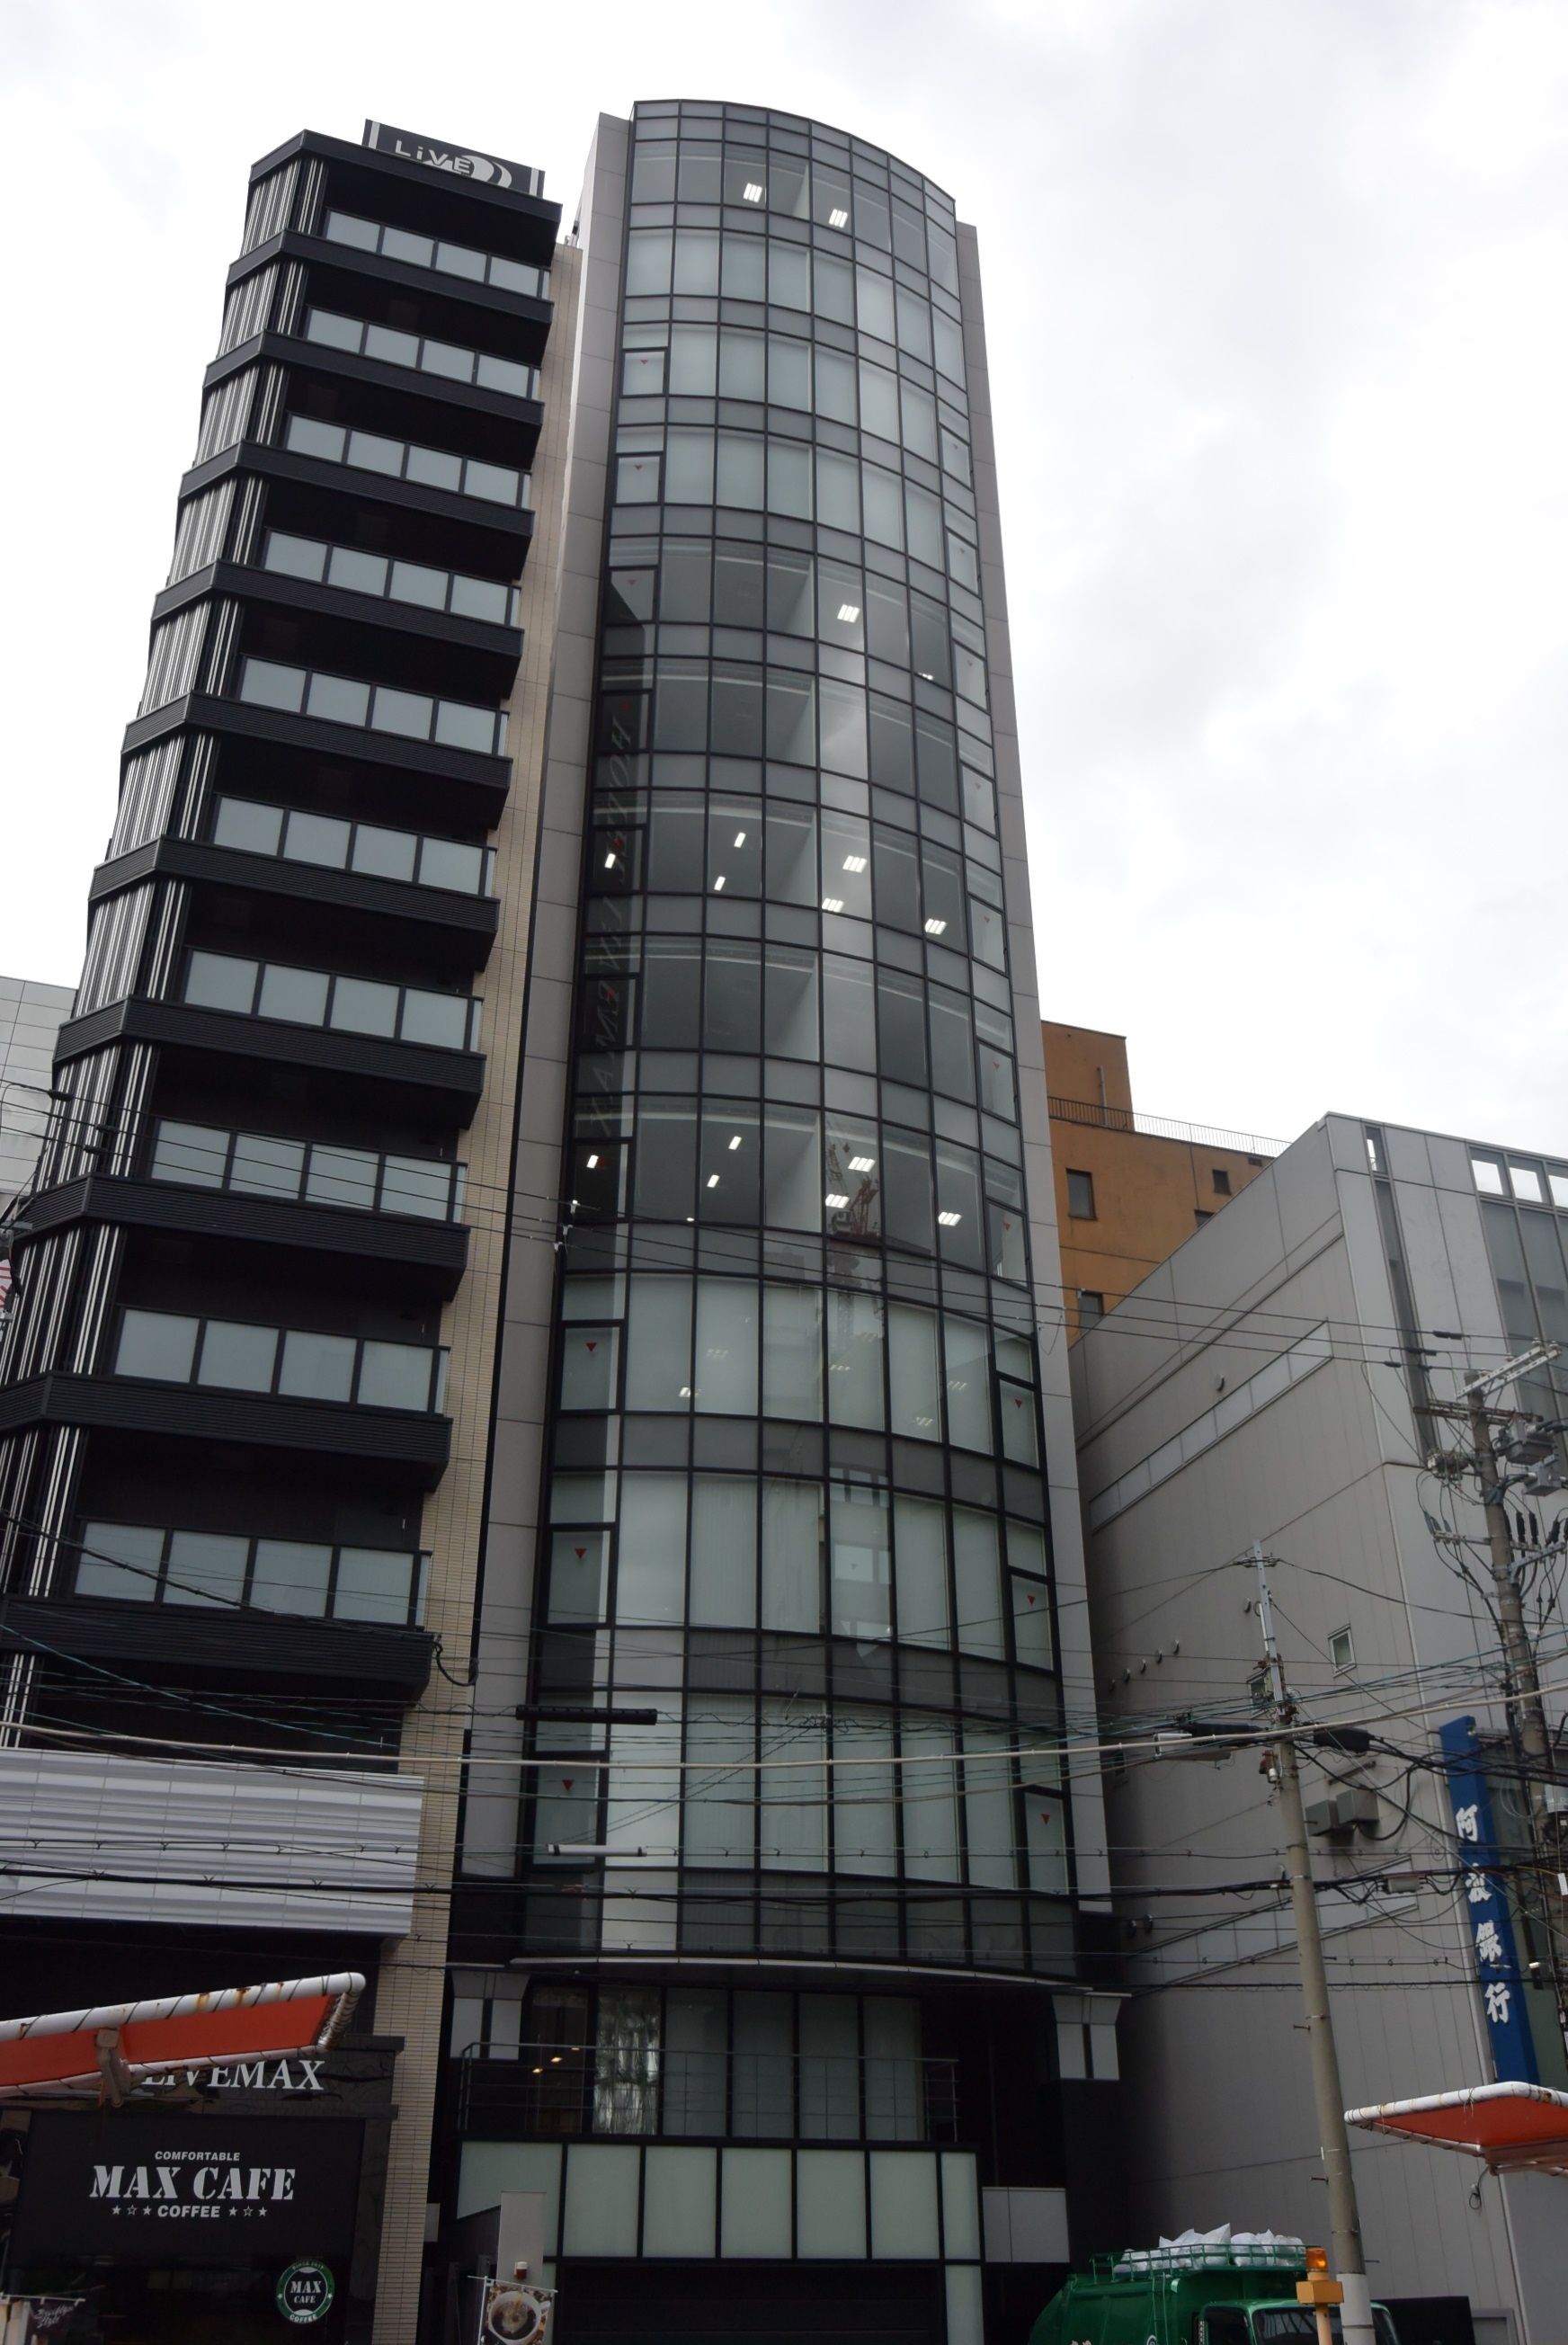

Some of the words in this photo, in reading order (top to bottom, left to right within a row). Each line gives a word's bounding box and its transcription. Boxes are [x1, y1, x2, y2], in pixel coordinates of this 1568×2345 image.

[1455, 1803, 1510, 2024] 阿波銀行
[155, 2151, 241, 2162] COMFORTABLE
[89, 2165, 181, 2198] MAX
[192, 2167, 296, 2200] CAFE
[157, 2205, 221, 2218] COFFEE
[290, 2280, 322, 2294] MAX
[293, 2295, 316, 2304] CAFE
[290, 2313, 318, 2323] COFFEE
